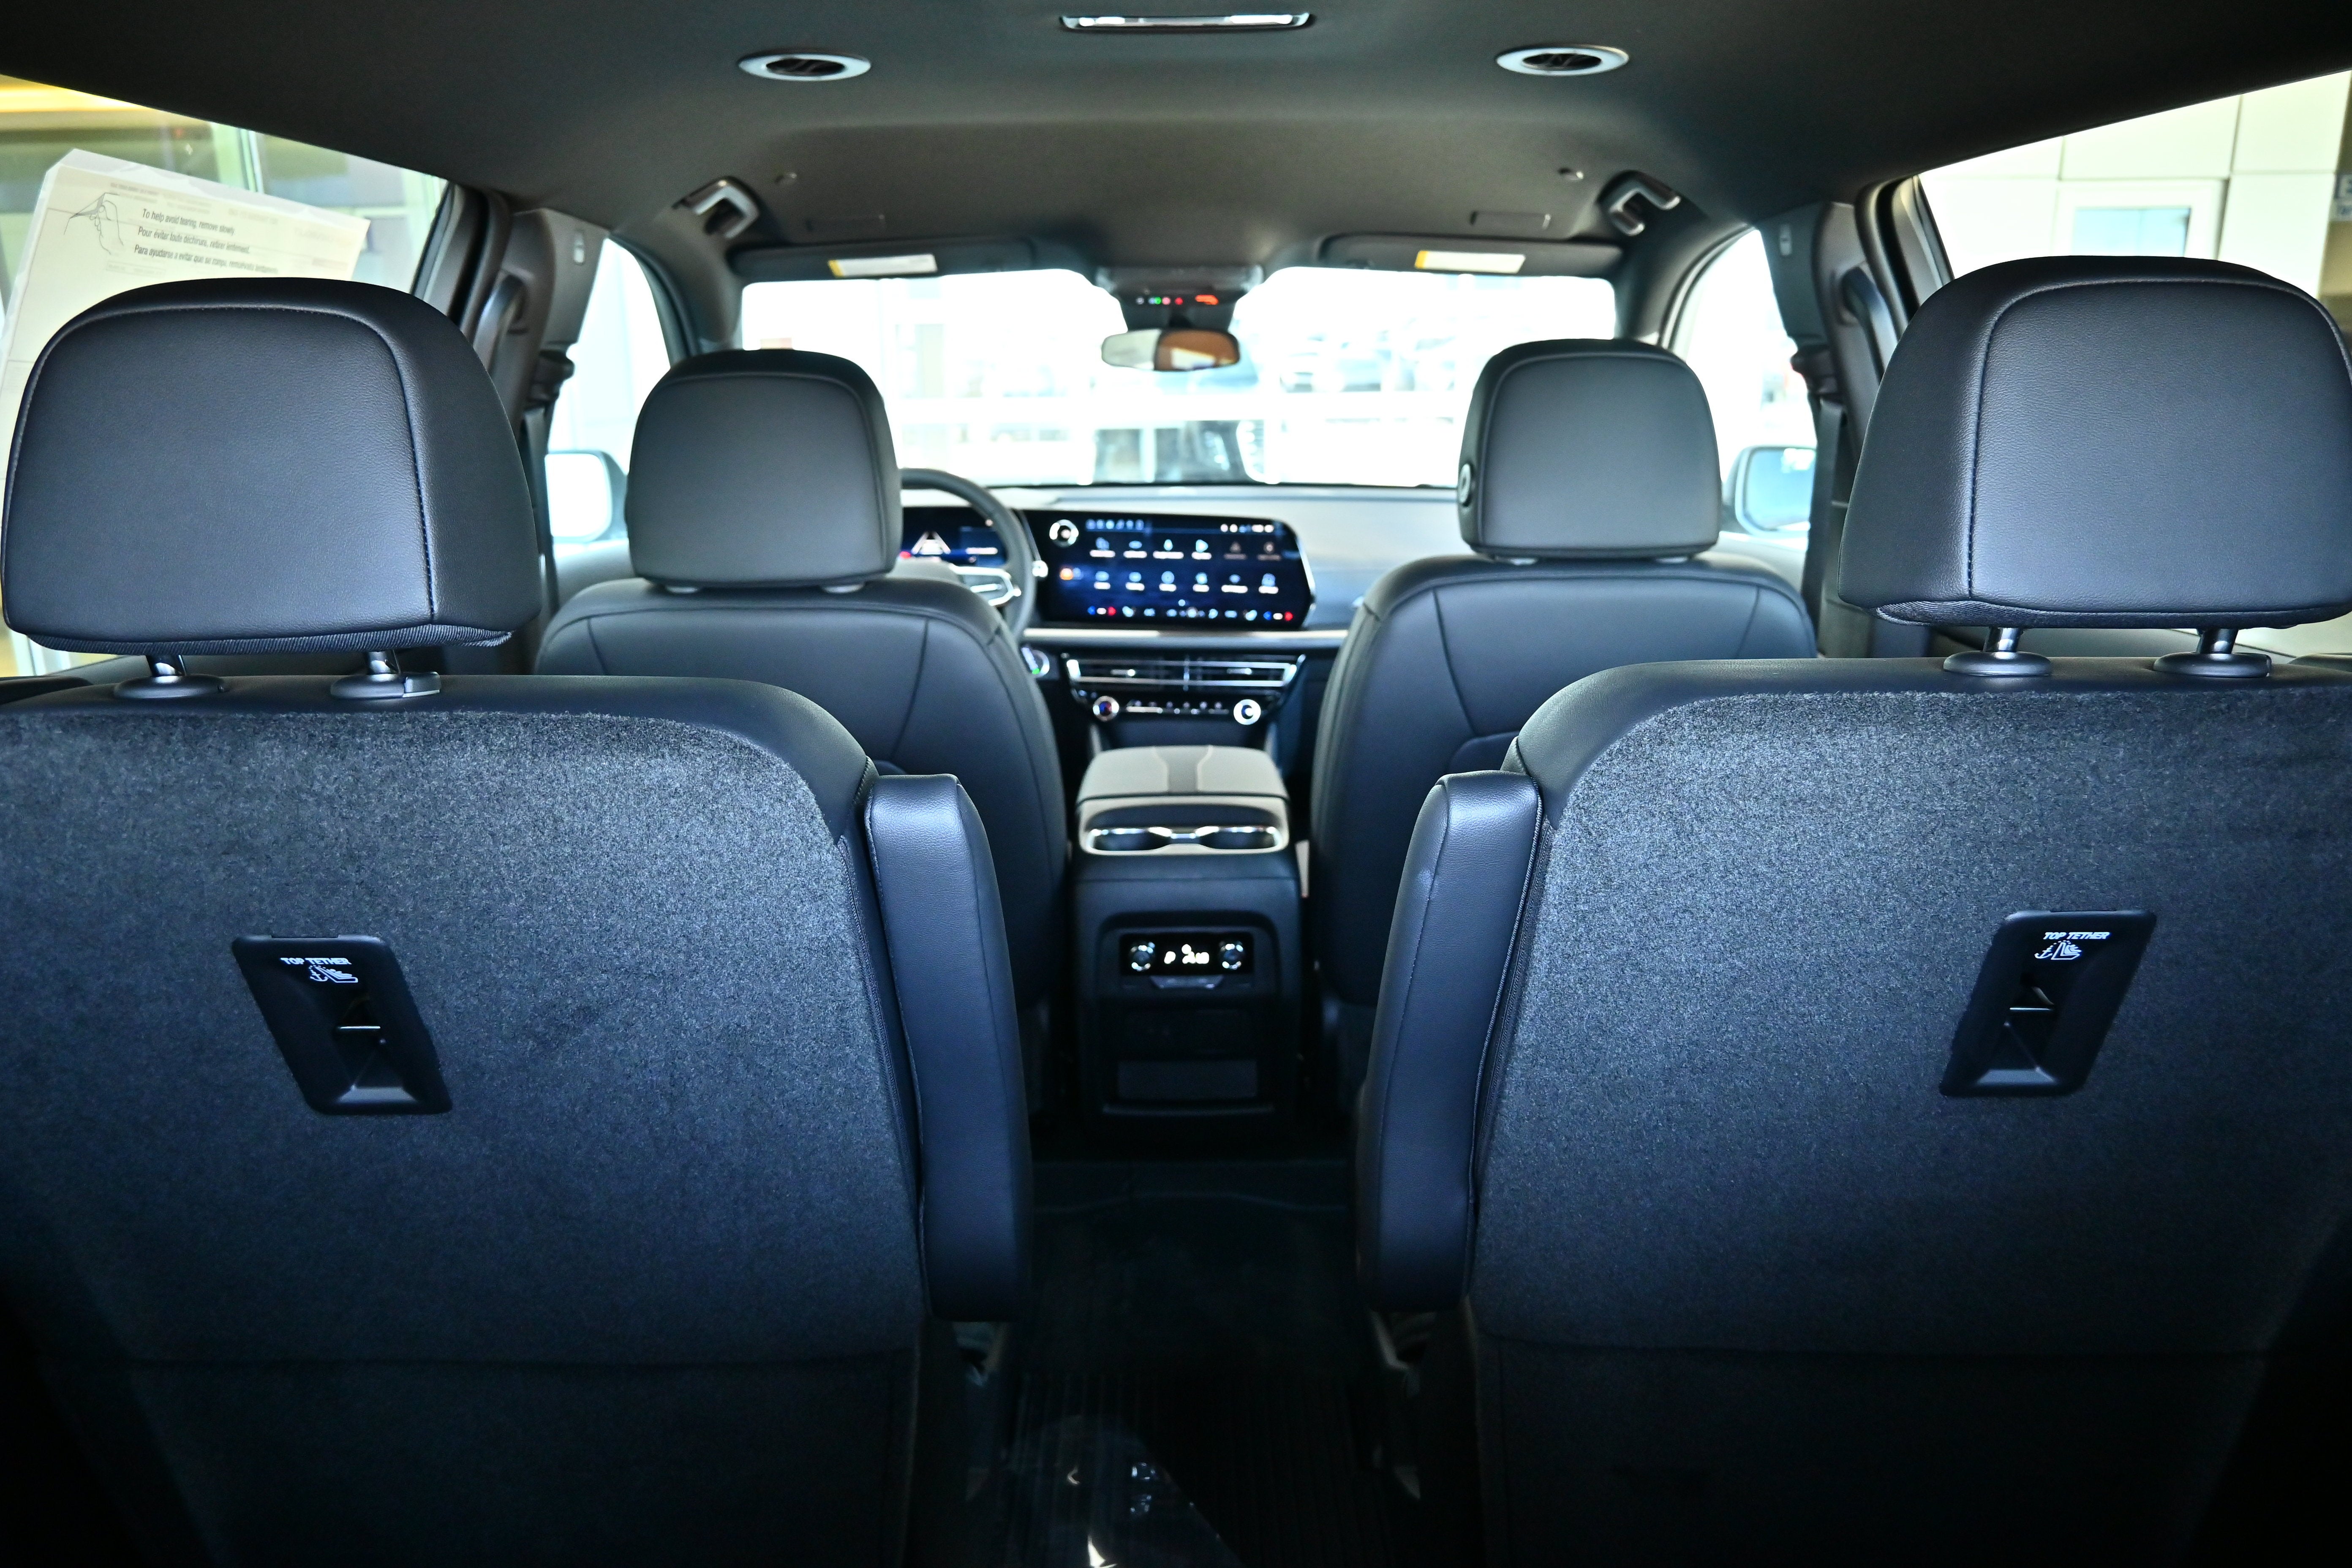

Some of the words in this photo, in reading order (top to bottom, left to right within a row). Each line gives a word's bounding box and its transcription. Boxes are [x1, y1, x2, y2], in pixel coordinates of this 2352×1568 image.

[143, 208, 150, 218] To
[151, 211, 164, 222] help
[165, 215, 179, 224] avoid
[199, 221, 218, 231] remove
[138, 226, 152, 237] Pour
[154, 229, 169, 240] éviter
[170, 232, 182, 242] toute
[210, 241, 225, 249] retirer
[134, 244, 148, 254] Para
[149, 248, 173, 259] ayudarse
[179, 253, 193, 261] evitar
[2066, 931, 2110, 939] TETHER
